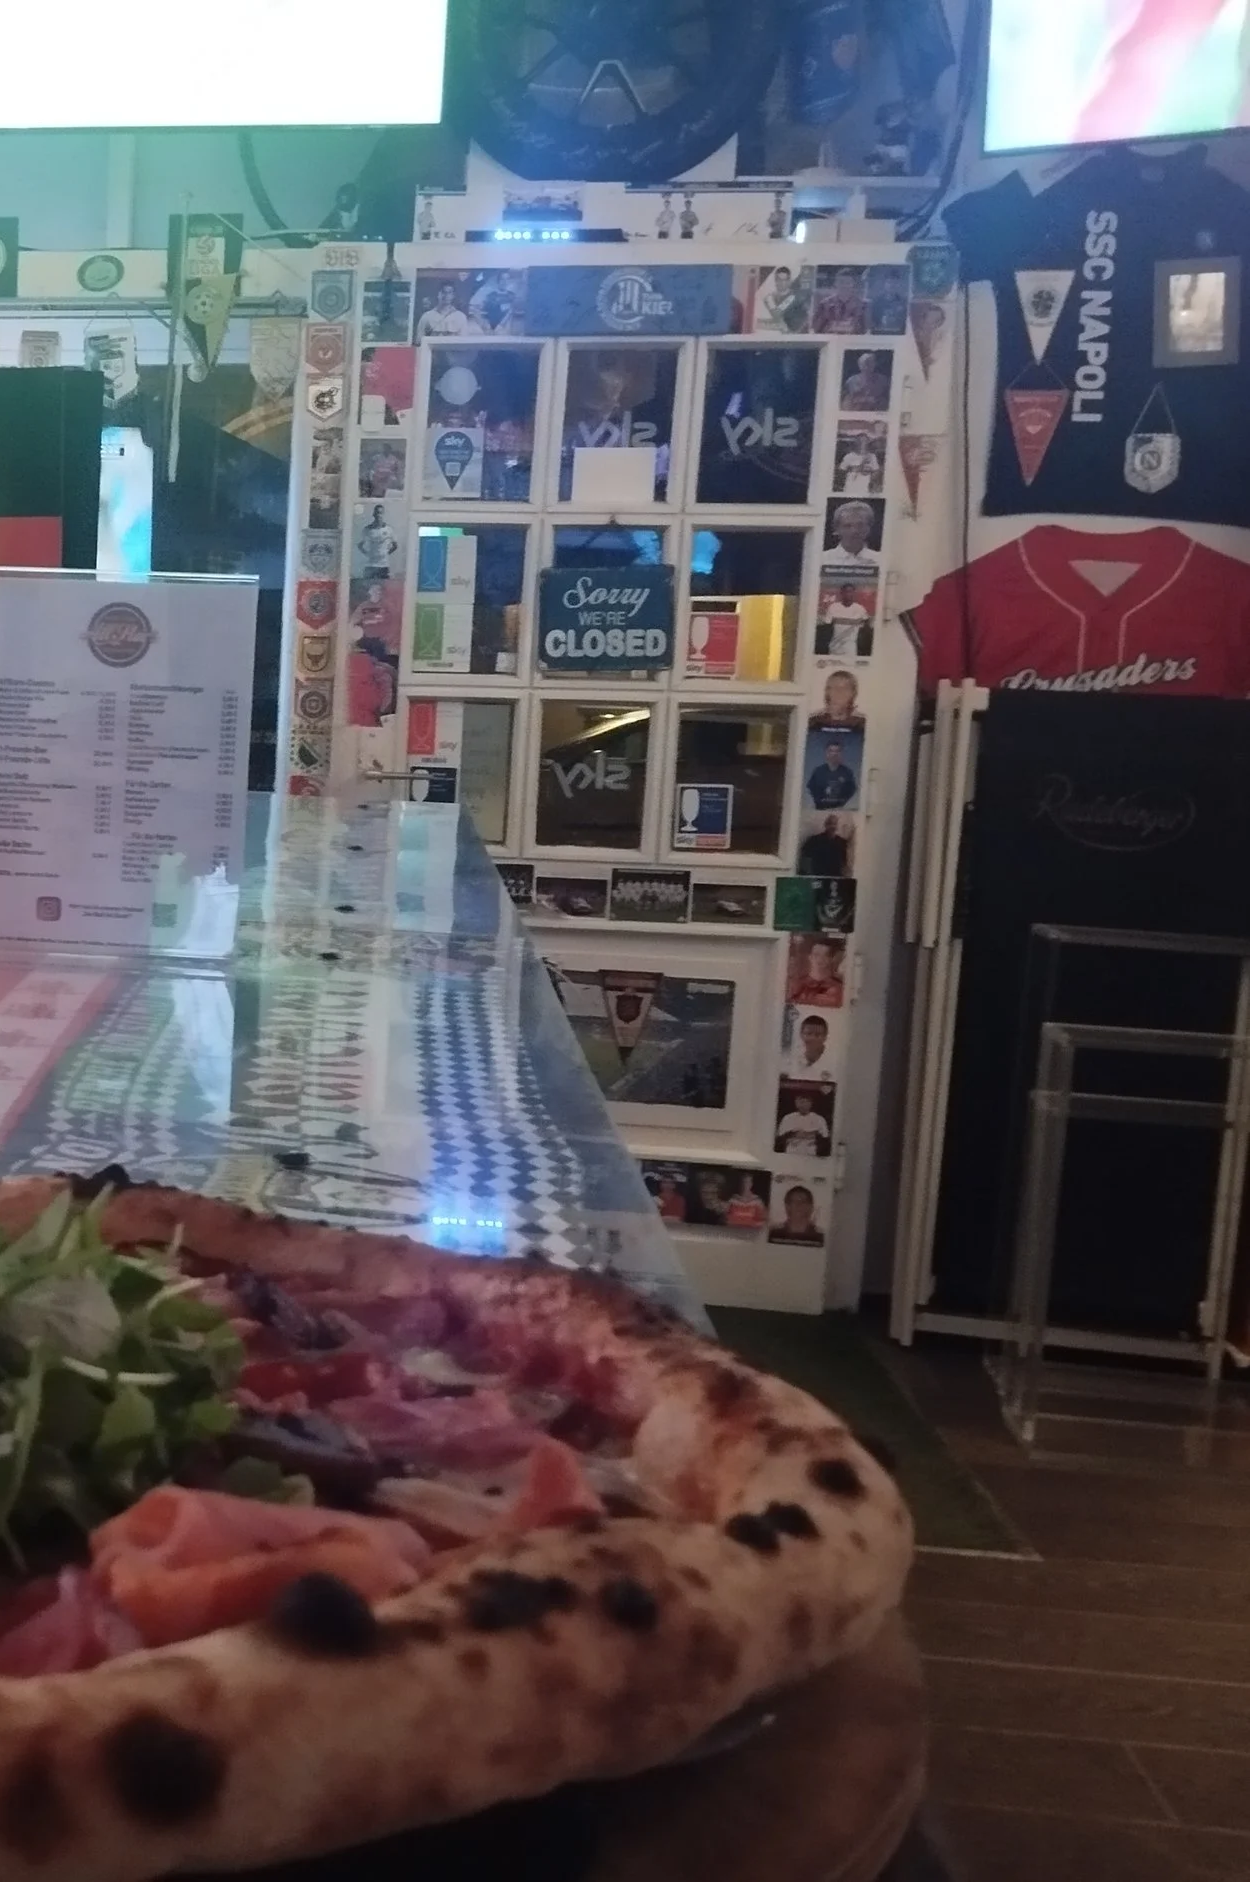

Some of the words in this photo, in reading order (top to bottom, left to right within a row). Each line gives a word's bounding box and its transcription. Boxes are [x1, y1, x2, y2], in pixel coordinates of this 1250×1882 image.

[1081, 209, 1117, 282] SSC
[1071, 290, 1113, 423] NAPOLI
[444, 436, 466, 448] sky
[562, 576, 651, 618] Sorry
[578, 611, 627, 626] WE'RE
[544, 628, 667, 658] CLOSED
